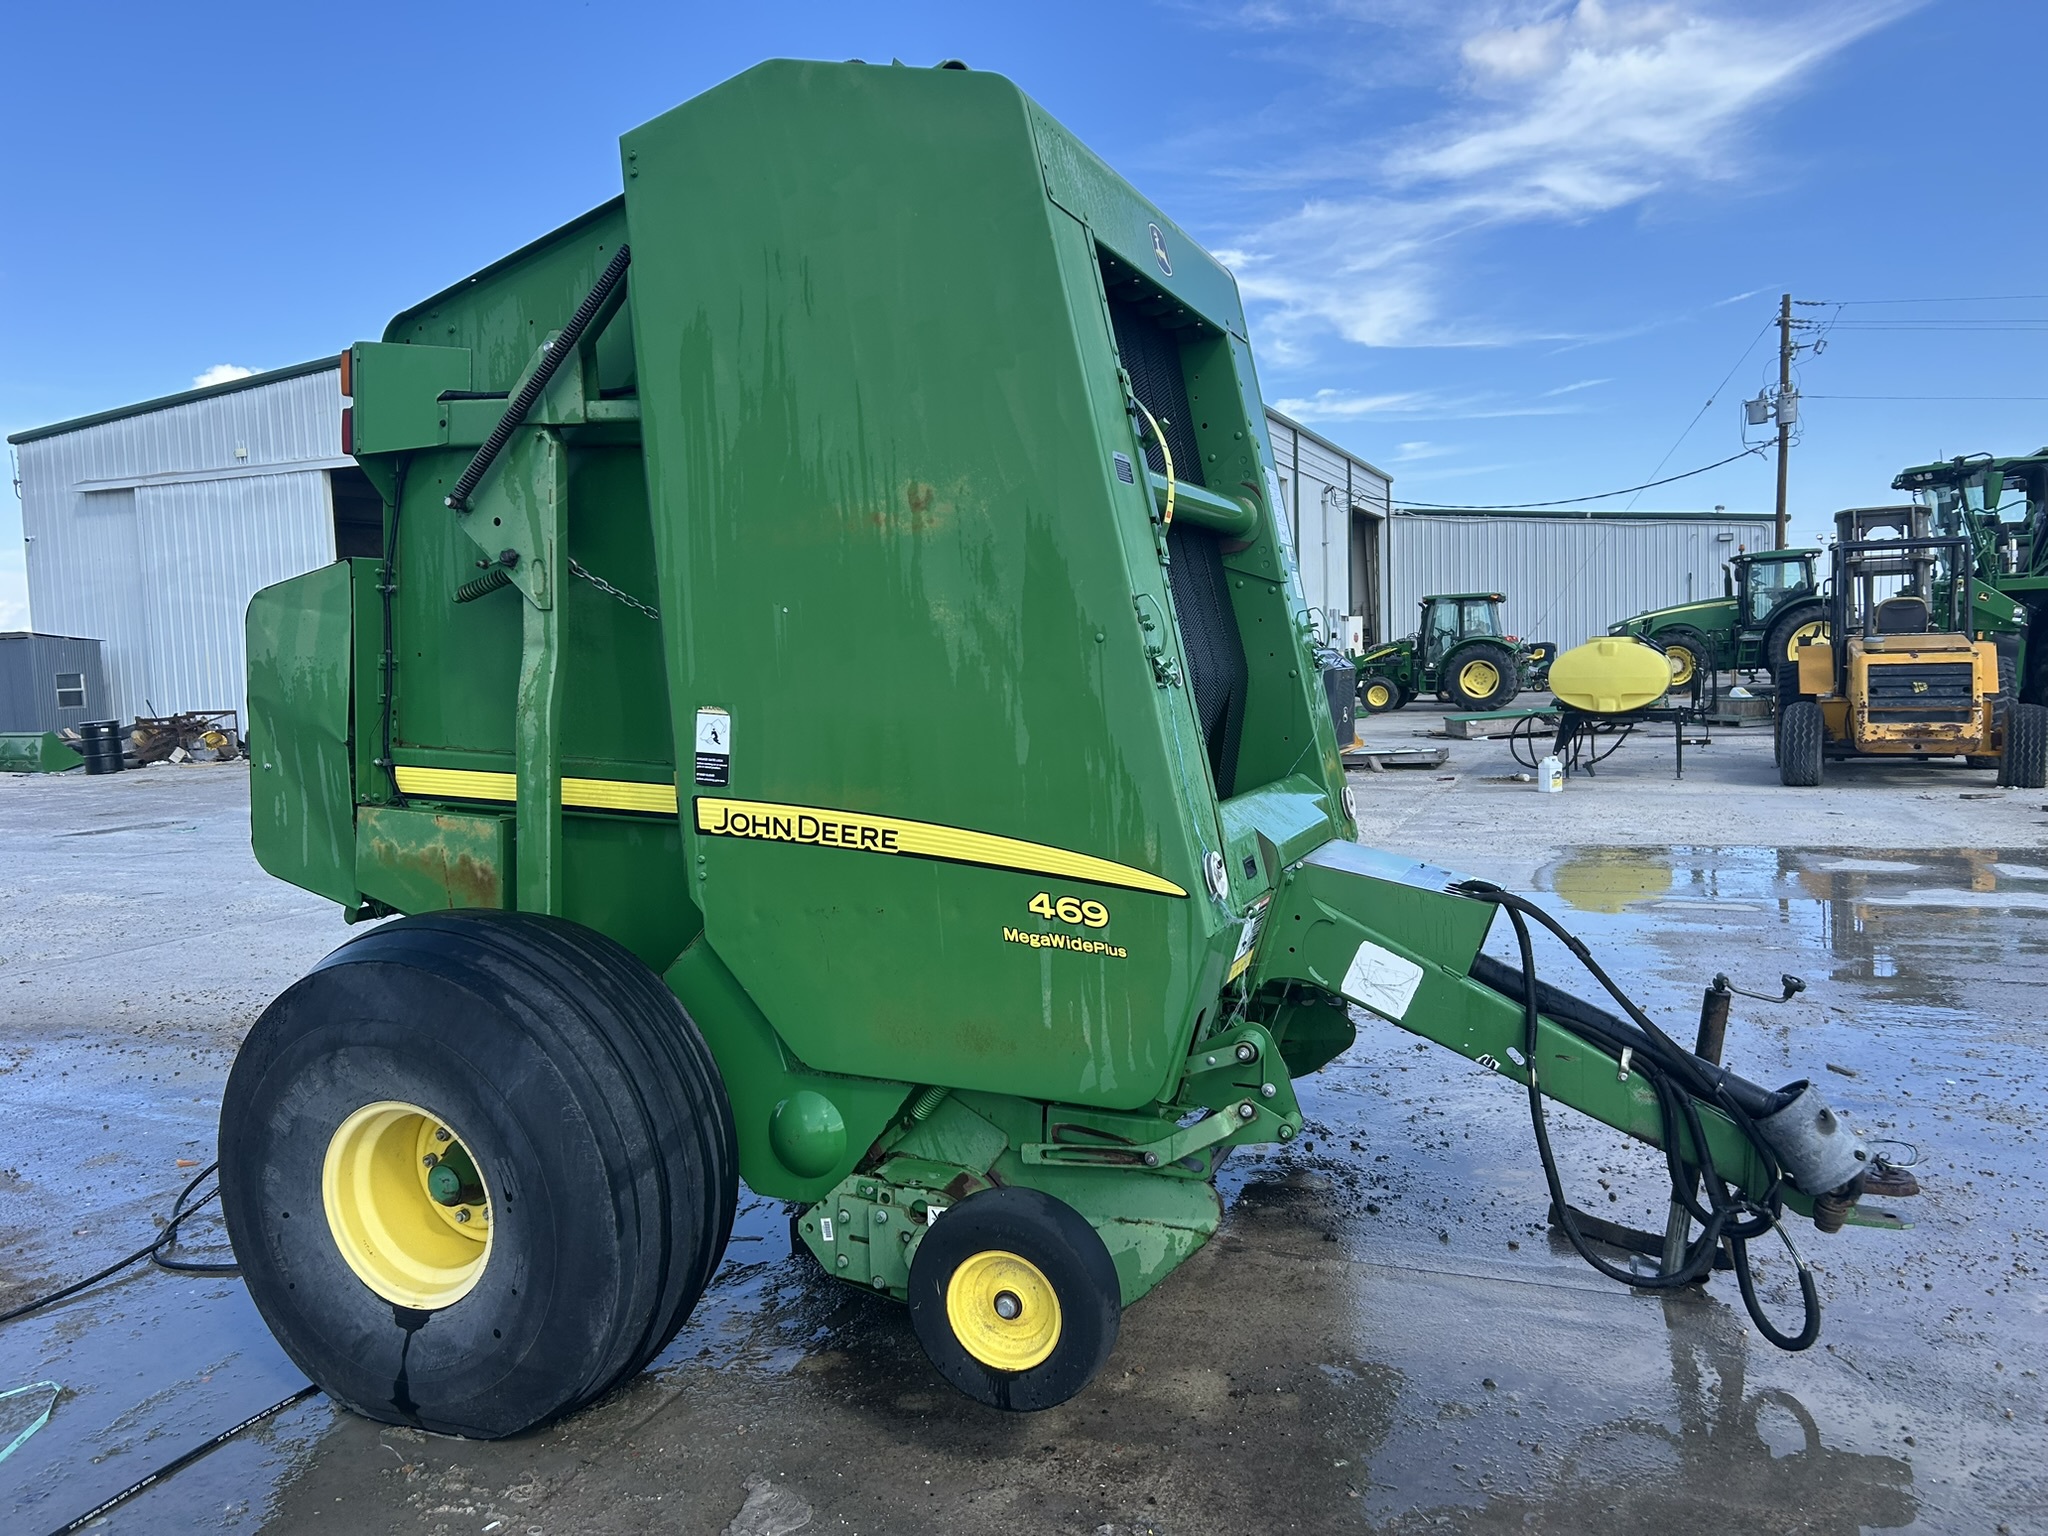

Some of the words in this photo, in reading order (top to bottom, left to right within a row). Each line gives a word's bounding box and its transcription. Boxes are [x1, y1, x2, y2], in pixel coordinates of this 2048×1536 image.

[714, 807, 792, 838] JOHN
[798, 814, 899, 850] DEERE
[1028, 892, 1110, 929] 469
[1002, 926, 1128, 958] MegaWidePlus
